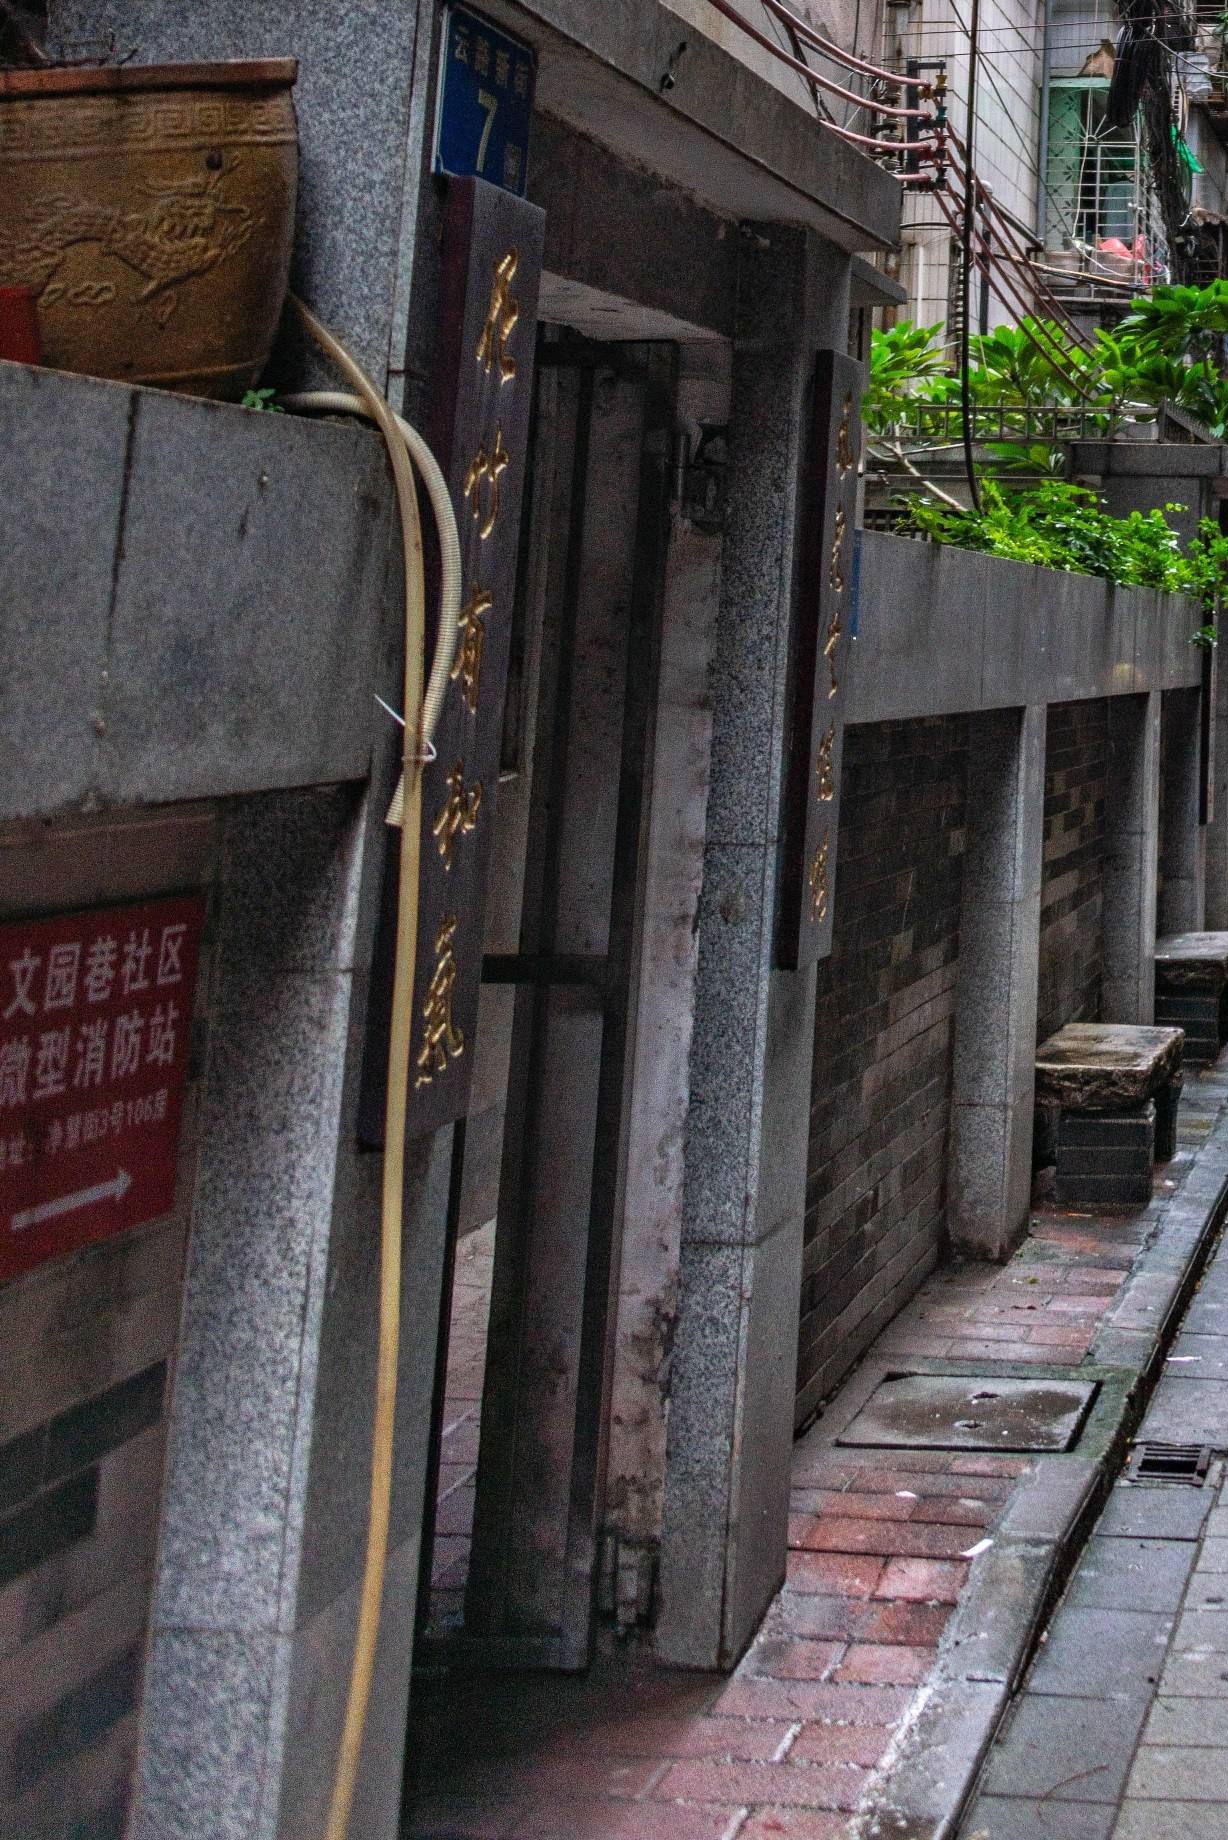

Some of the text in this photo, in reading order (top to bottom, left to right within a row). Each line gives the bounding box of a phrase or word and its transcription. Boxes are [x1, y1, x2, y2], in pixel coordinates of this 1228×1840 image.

[476, 87, 498, 172] 7
[3, 923, 188, 1019] 文园巷社区
[0, 998, 180, 1108] 微型消防站
